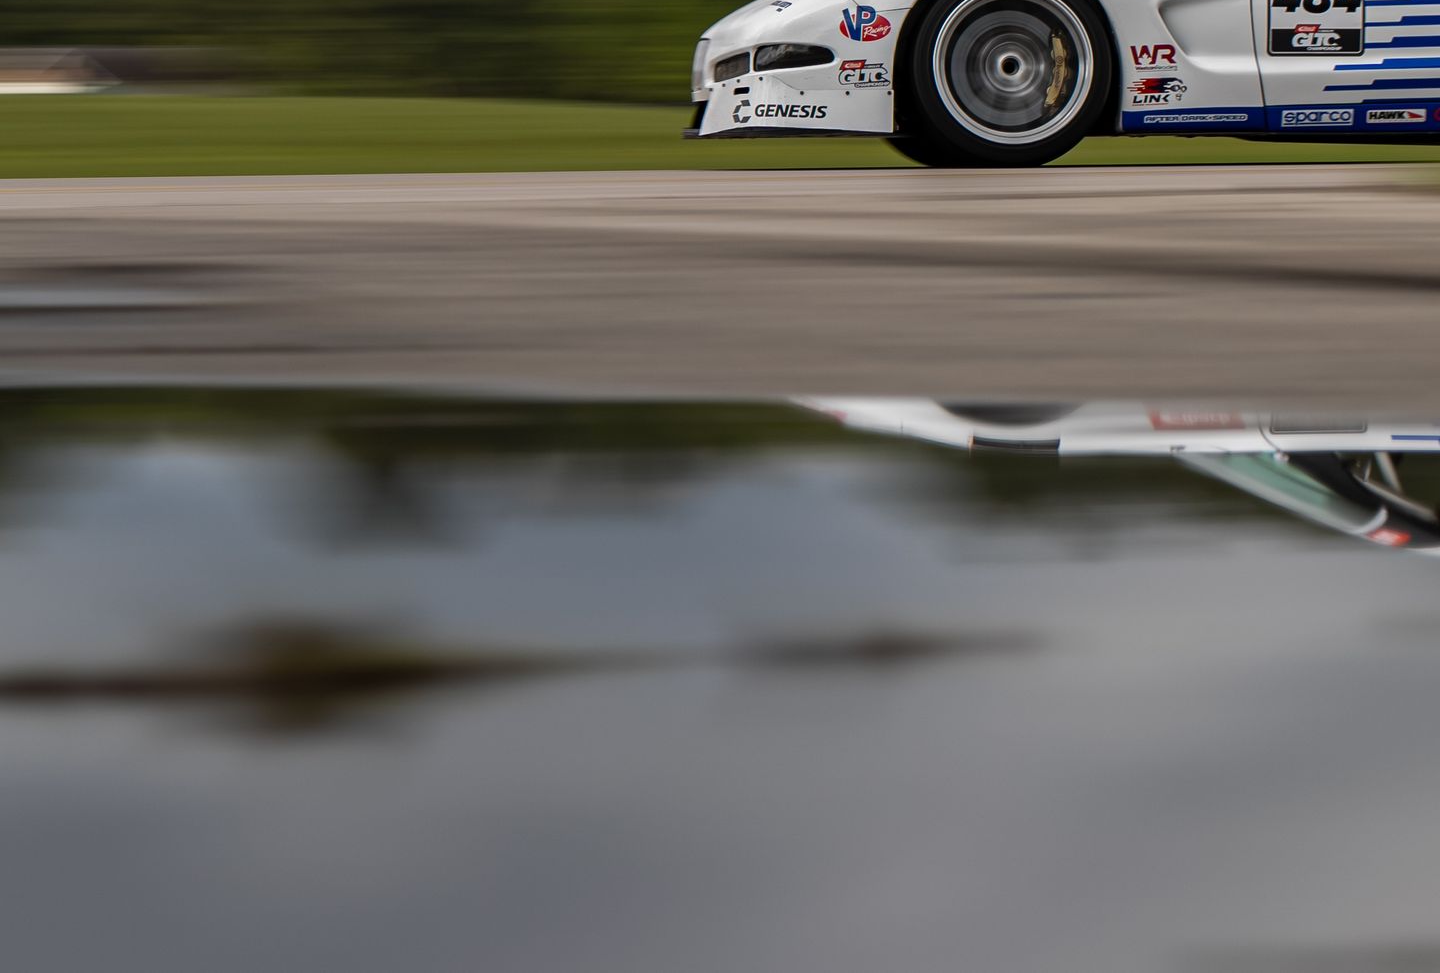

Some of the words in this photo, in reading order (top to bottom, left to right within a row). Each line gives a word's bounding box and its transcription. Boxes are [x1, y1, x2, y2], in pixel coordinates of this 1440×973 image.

[842, 5, 876, 41] VP
[863, 24, 891, 38] Racing
[1130, 44, 1176, 65] WR
[1133, 94, 1170, 103] LINK
[755, 104, 828, 119] GENESIS
[1283, 111, 1352, 125] sparco
[1368, 111, 1406, 120] HAWK
